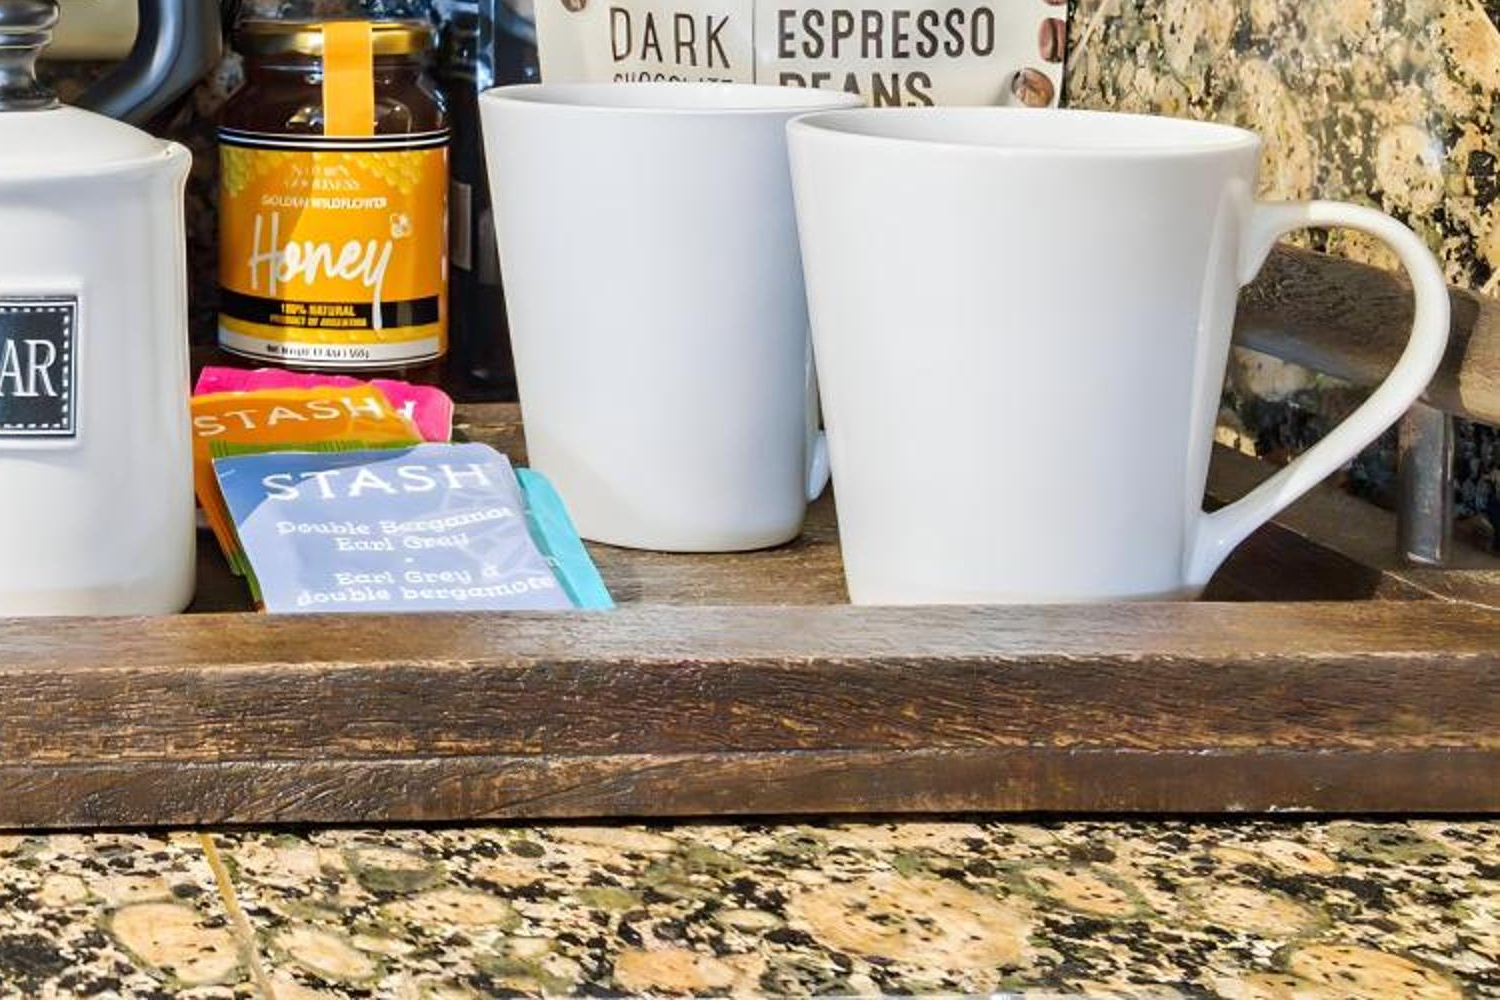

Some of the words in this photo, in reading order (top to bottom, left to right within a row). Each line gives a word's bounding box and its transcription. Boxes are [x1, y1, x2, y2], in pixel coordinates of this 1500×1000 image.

[609, 6, 731, 69] DARK
[777, 6, 996, 59] ESPRESSO
[249, 211, 393, 330] Honey
[309, 305, 356, 317] NATURAL
[193, 395, 386, 437] STASH
[261, 462, 493, 502] STASH
[275, 519, 371, 536] Double
[380, 506, 517, 535] Bergamot
[335, 536, 396, 552] Earl
[296, 586, 391, 607] double
[401, 574, 557, 602] bergamote
[334, 570, 395, 586] Earl
[404, 570, 472, 585] Grey
